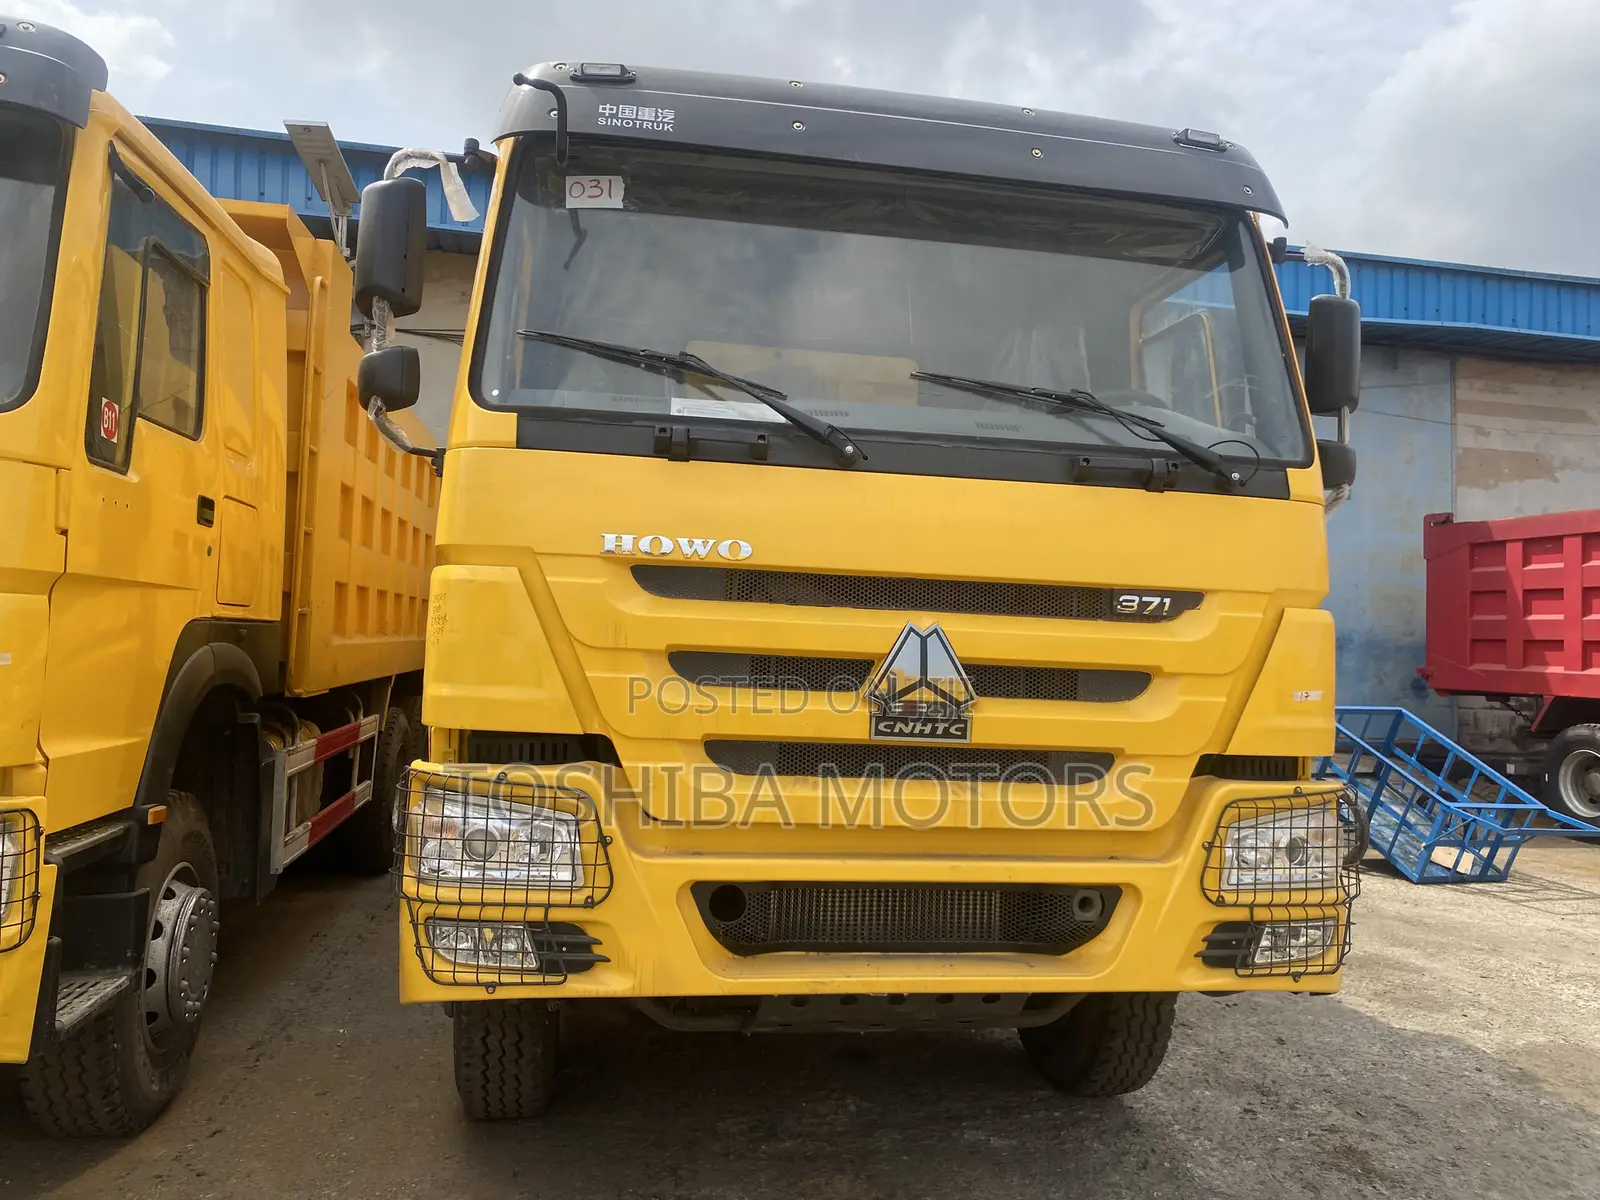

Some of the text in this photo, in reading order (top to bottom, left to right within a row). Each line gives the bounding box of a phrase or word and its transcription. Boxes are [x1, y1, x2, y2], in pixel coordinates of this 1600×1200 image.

[598, 103, 675, 123] 中国重汽
[597, 117, 674, 132] SINOTRUK
[568, 179, 612, 199] 031
[103, 406, 115, 432] B11
[601, 533, 753, 561] HOWO
[1116, 595, 1171, 616] 371
[877, 720, 965, 736] CNHTC
